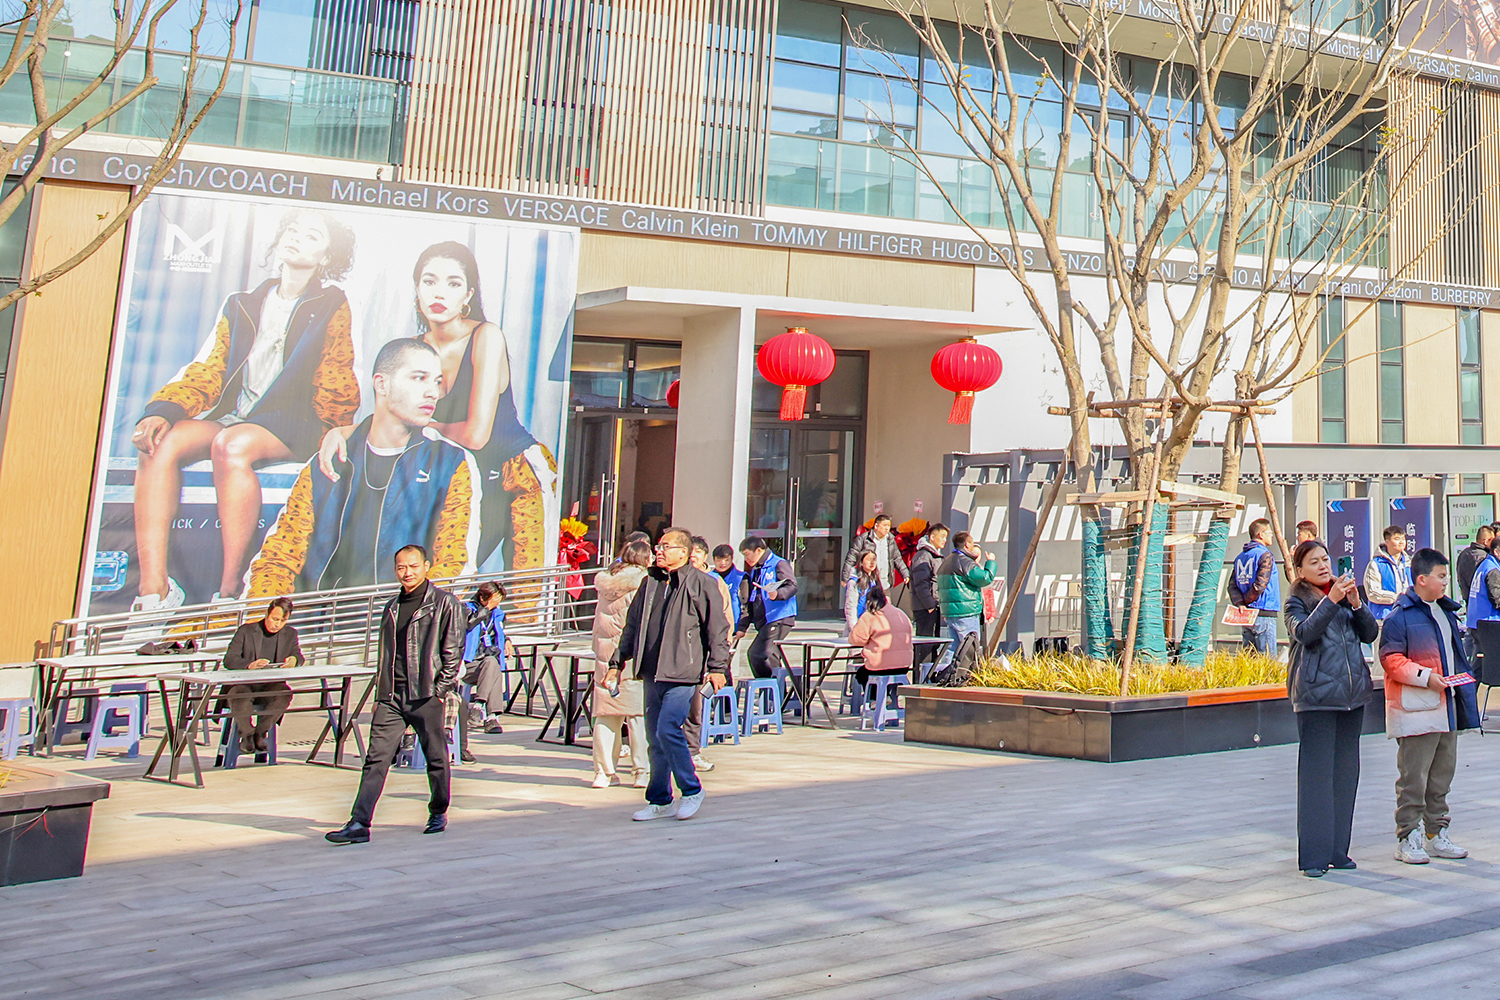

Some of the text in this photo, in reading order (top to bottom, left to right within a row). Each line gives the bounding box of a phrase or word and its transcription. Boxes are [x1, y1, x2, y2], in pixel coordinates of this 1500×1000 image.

[1408, 54, 1461, 78] VERSACE
[1467, 66, 1499, 86] Calvin
[331, 179, 429, 209] Michael
[436, 190, 490, 215] Kors
[503, 197, 610, 227] VERSACE
[621, 209, 685, 234] Calvin
[691, 217, 740, 239] Klein
[751, 222, 828, 247] TOMMY
[838, 231, 923, 256] HILFIGER
[932, 240, 983, 261] HUGO
[1431, 287, 1492, 306] BURBERRY
